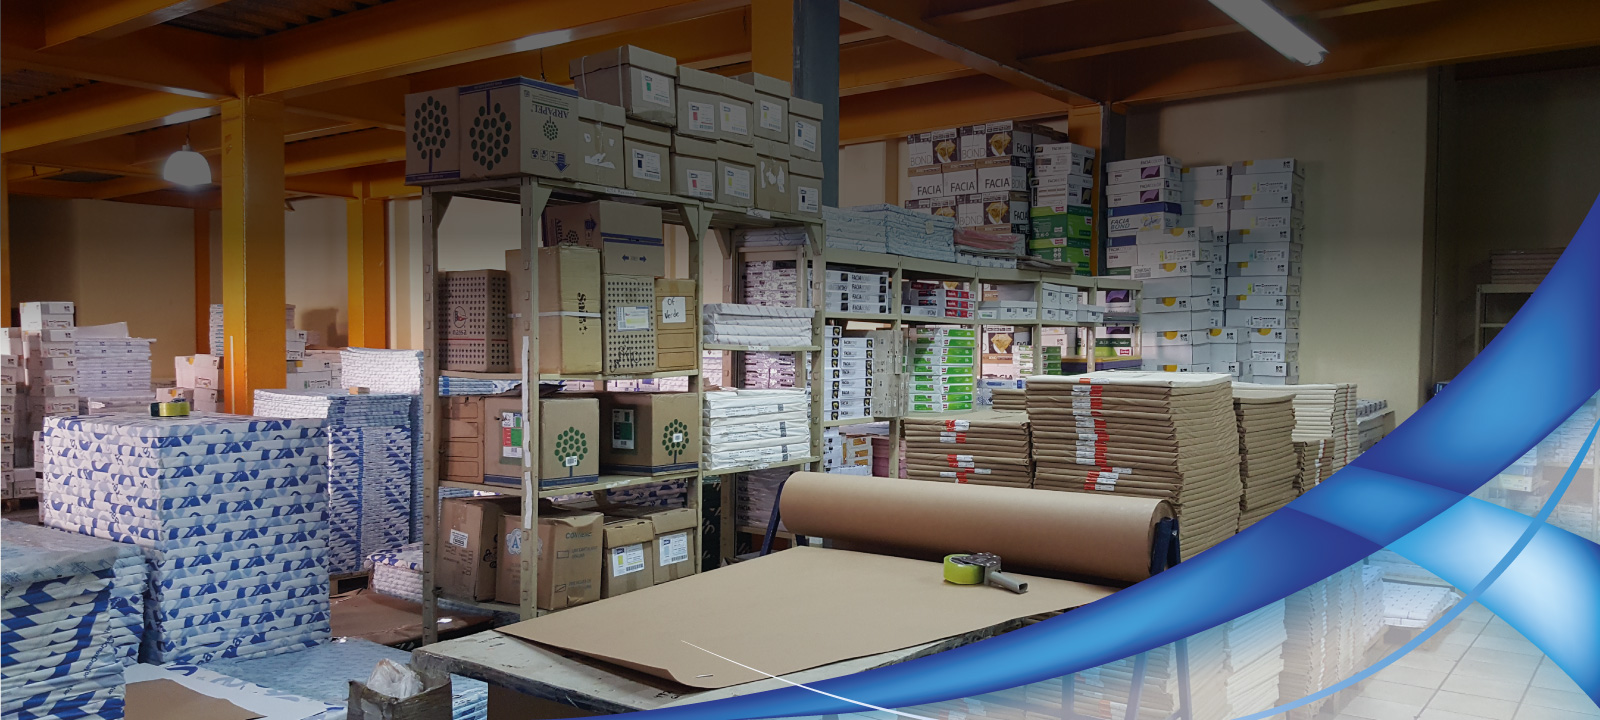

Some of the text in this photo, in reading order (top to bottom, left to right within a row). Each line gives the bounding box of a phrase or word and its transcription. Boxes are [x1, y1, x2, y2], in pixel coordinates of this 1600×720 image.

[531, 104, 570, 119] ARPAPEL
[962, 147, 986, 159] BOND
[910, 154, 933, 167] BOND
[950, 181, 975, 192] FACIA
[985, 178, 1010, 189] FACIA
[917, 185, 942, 197] FACIA
[959, 215, 984, 227] BOND
[1110, 217, 1130, 225] FACIA
